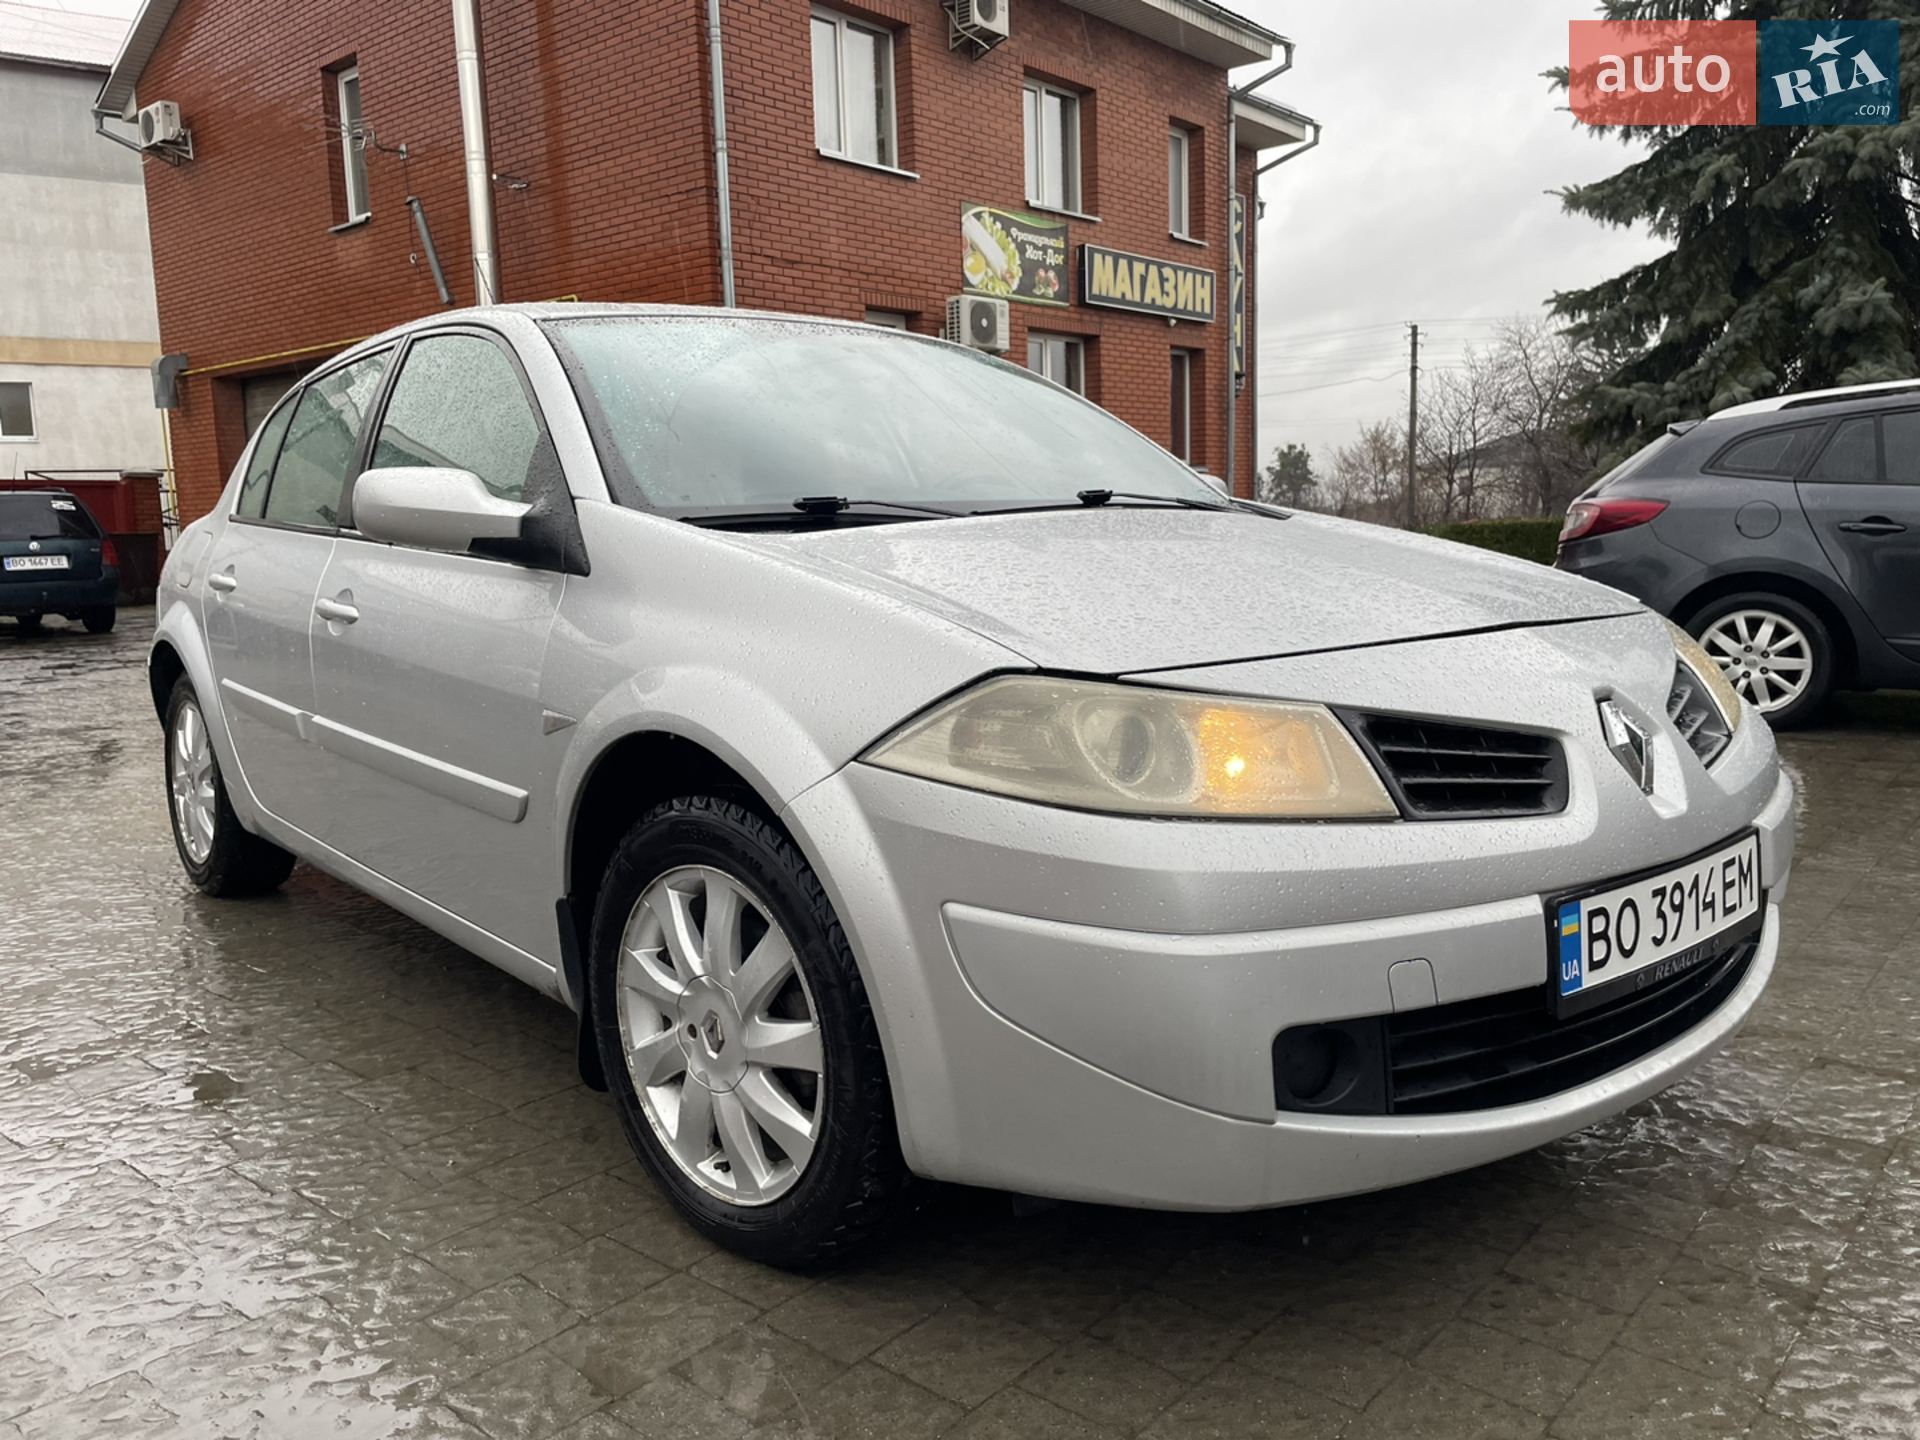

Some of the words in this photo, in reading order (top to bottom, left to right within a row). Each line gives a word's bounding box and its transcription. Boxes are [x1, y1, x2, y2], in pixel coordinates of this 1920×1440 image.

[1091, 252, 1211, 314] МАГАЗИН
[1587, 897, 1640, 973] BO
[1651, 866, 1716, 947] 3914
[1722, 847, 1754, 918] EM
[1562, 959, 1580, 982] UA
[1654, 946, 1705, 982] RENAULT
